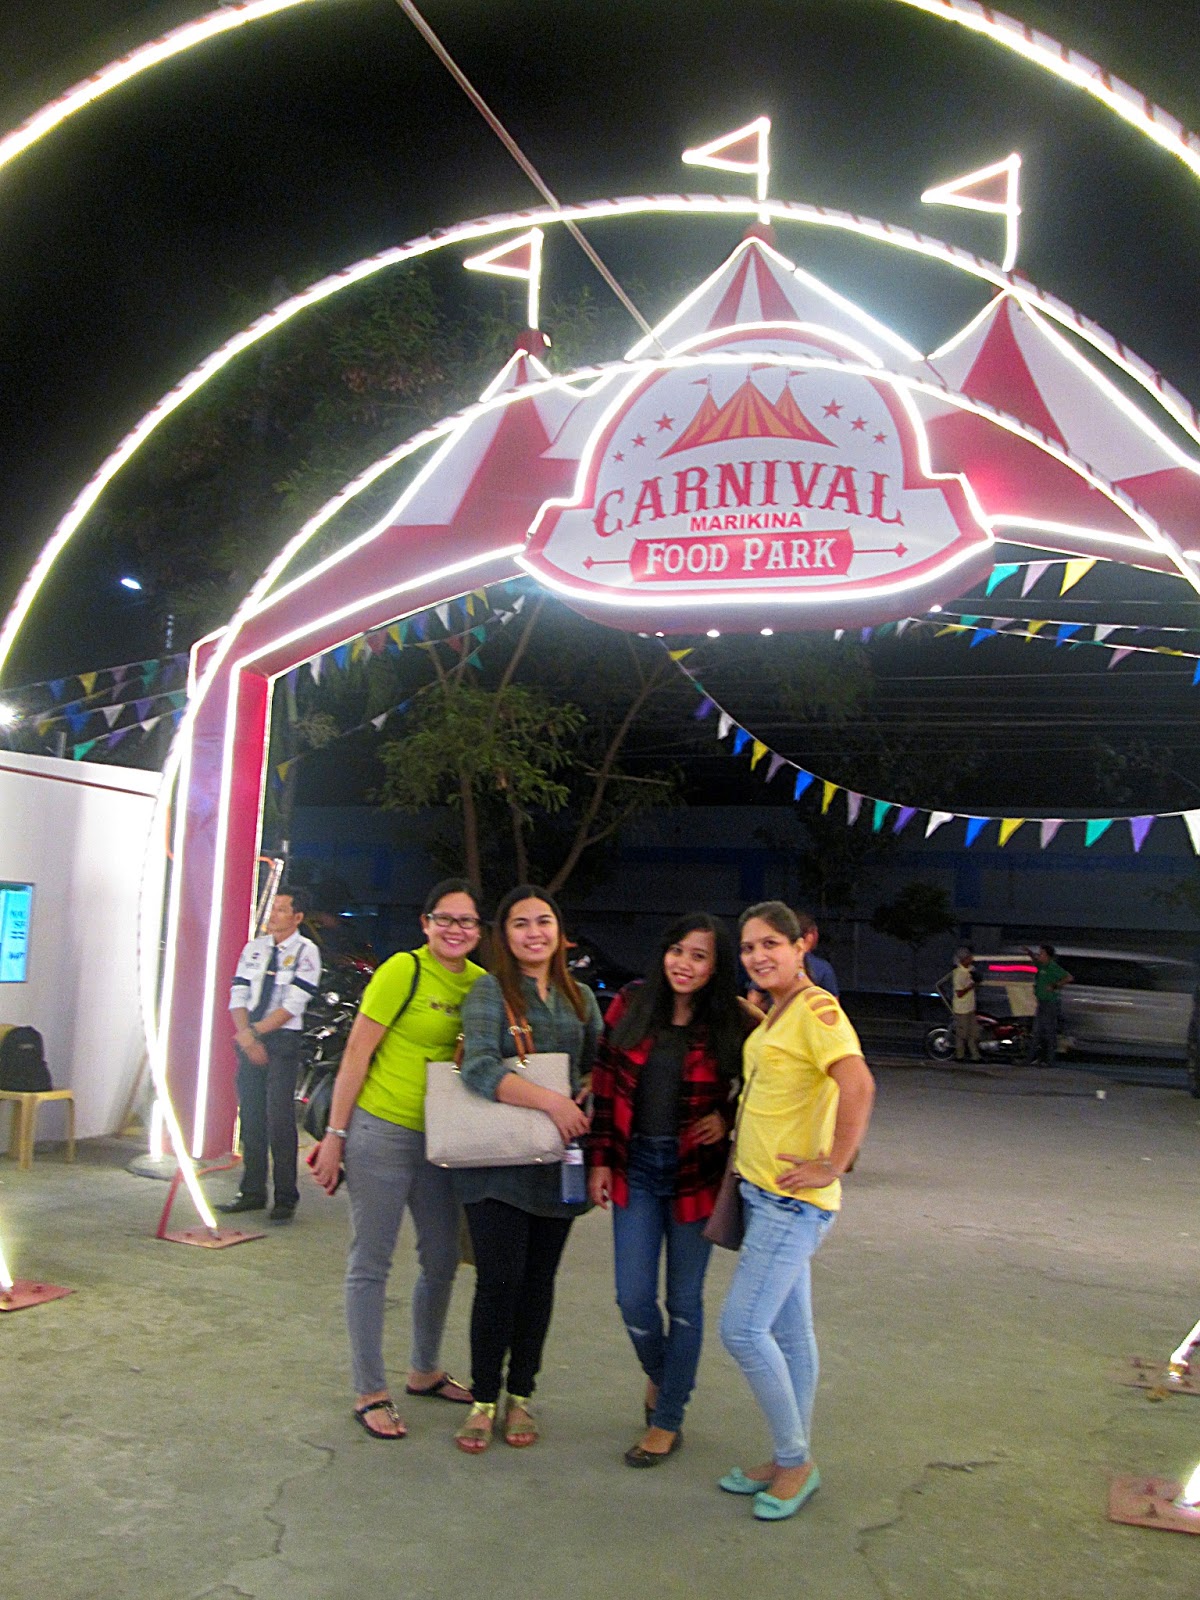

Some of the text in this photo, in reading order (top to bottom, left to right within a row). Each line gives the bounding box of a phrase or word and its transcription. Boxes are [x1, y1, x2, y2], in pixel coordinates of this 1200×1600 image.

[593, 460, 904, 537] CARNIVAL
[690, 512, 802, 532] MARIKINA
[645, 536, 837, 575] FOOD PARK
